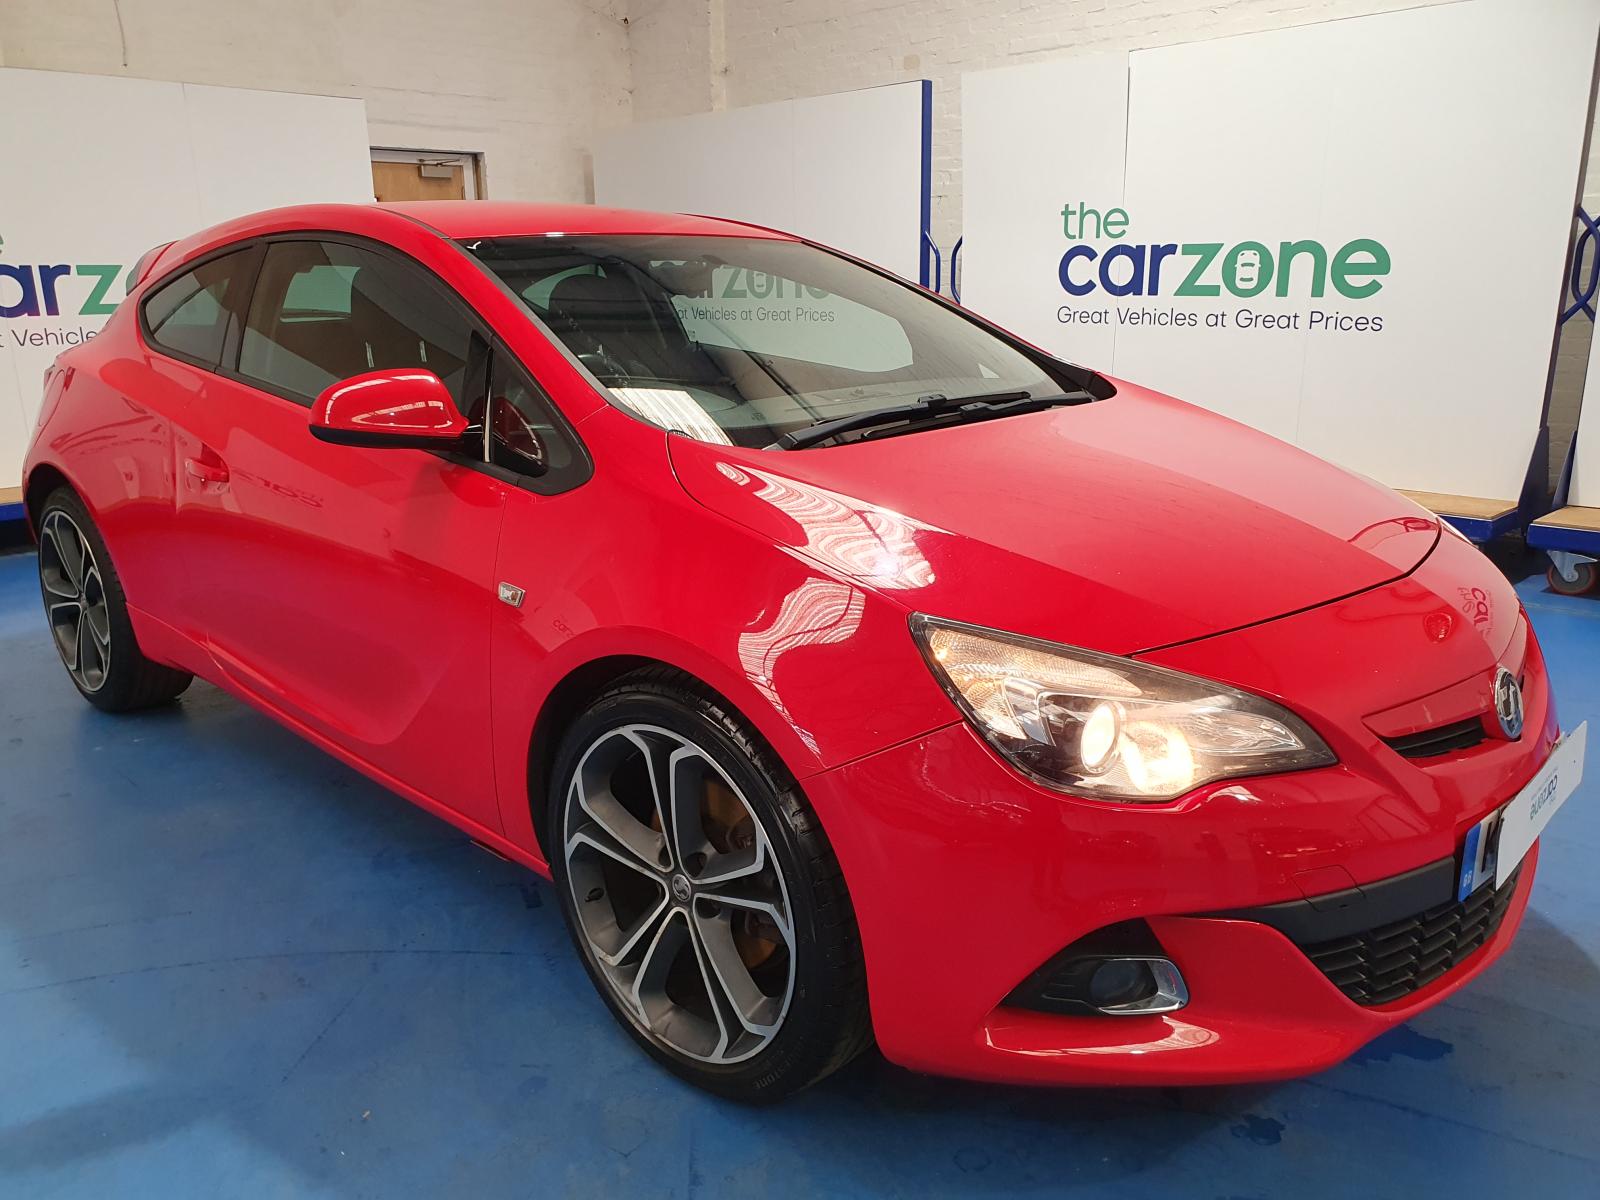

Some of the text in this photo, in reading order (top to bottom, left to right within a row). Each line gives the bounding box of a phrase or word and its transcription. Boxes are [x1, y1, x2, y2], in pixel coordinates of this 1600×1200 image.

[1060, 201, 1130, 240] the
[1058, 238, 1392, 299] carzone
[691, 306, 737, 321] Vehicles
[740, 308, 753, 321] at
[756, 306, 792, 322] Great
[795, 306, 836, 323] Prices
[1057, 305, 1384, 332] Great Vehicles at Great Prices
[11, 326, 99, 347] Vehicle
